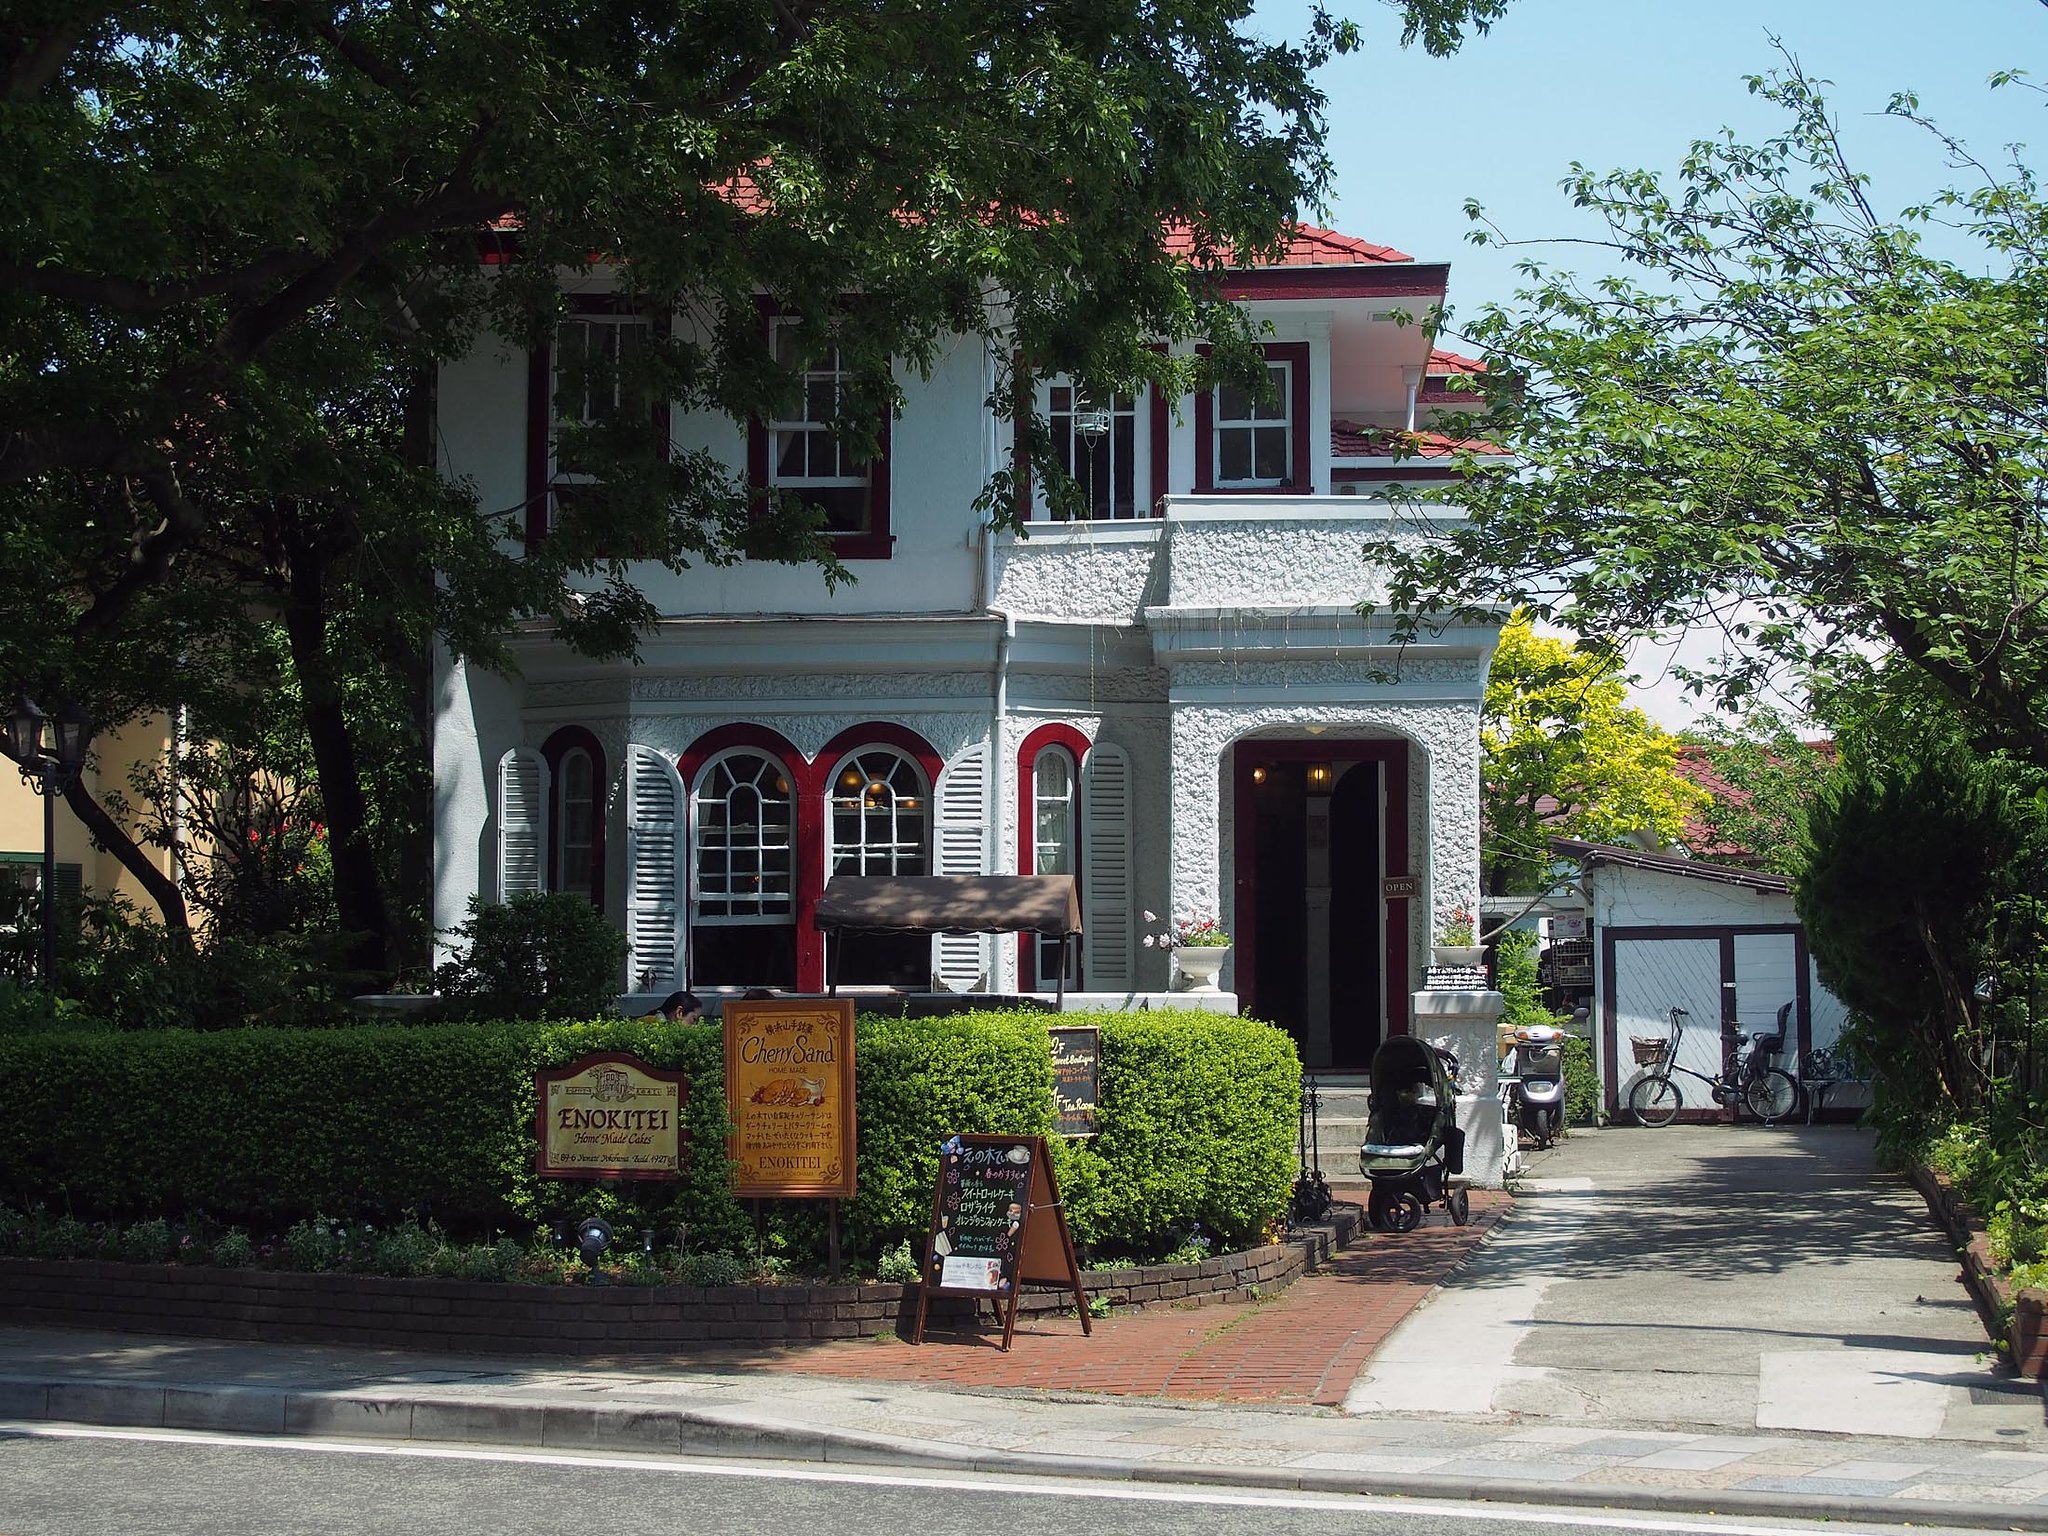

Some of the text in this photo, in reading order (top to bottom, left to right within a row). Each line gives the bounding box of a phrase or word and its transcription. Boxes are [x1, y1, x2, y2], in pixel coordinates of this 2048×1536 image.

[1385, 882, 1413, 892] OPEN
[741, 1035, 836, 1065] Cherry Sand
[1050, 1036, 1065, 1054] 2F
[1051, 1086, 1064, 1108] 1F
[1062, 1098, 1077, 1112] Tea
[558, 1107, 669, 1130] ENOKITEI
[574, 1132, 654, 1145] Home Made Cakes
[759, 1156, 820, 1169] ENOKITEI
[961, 1187, 1015, 1201] スイートロールケーキ
[960, 1200, 996, 1214] ロザライチ
